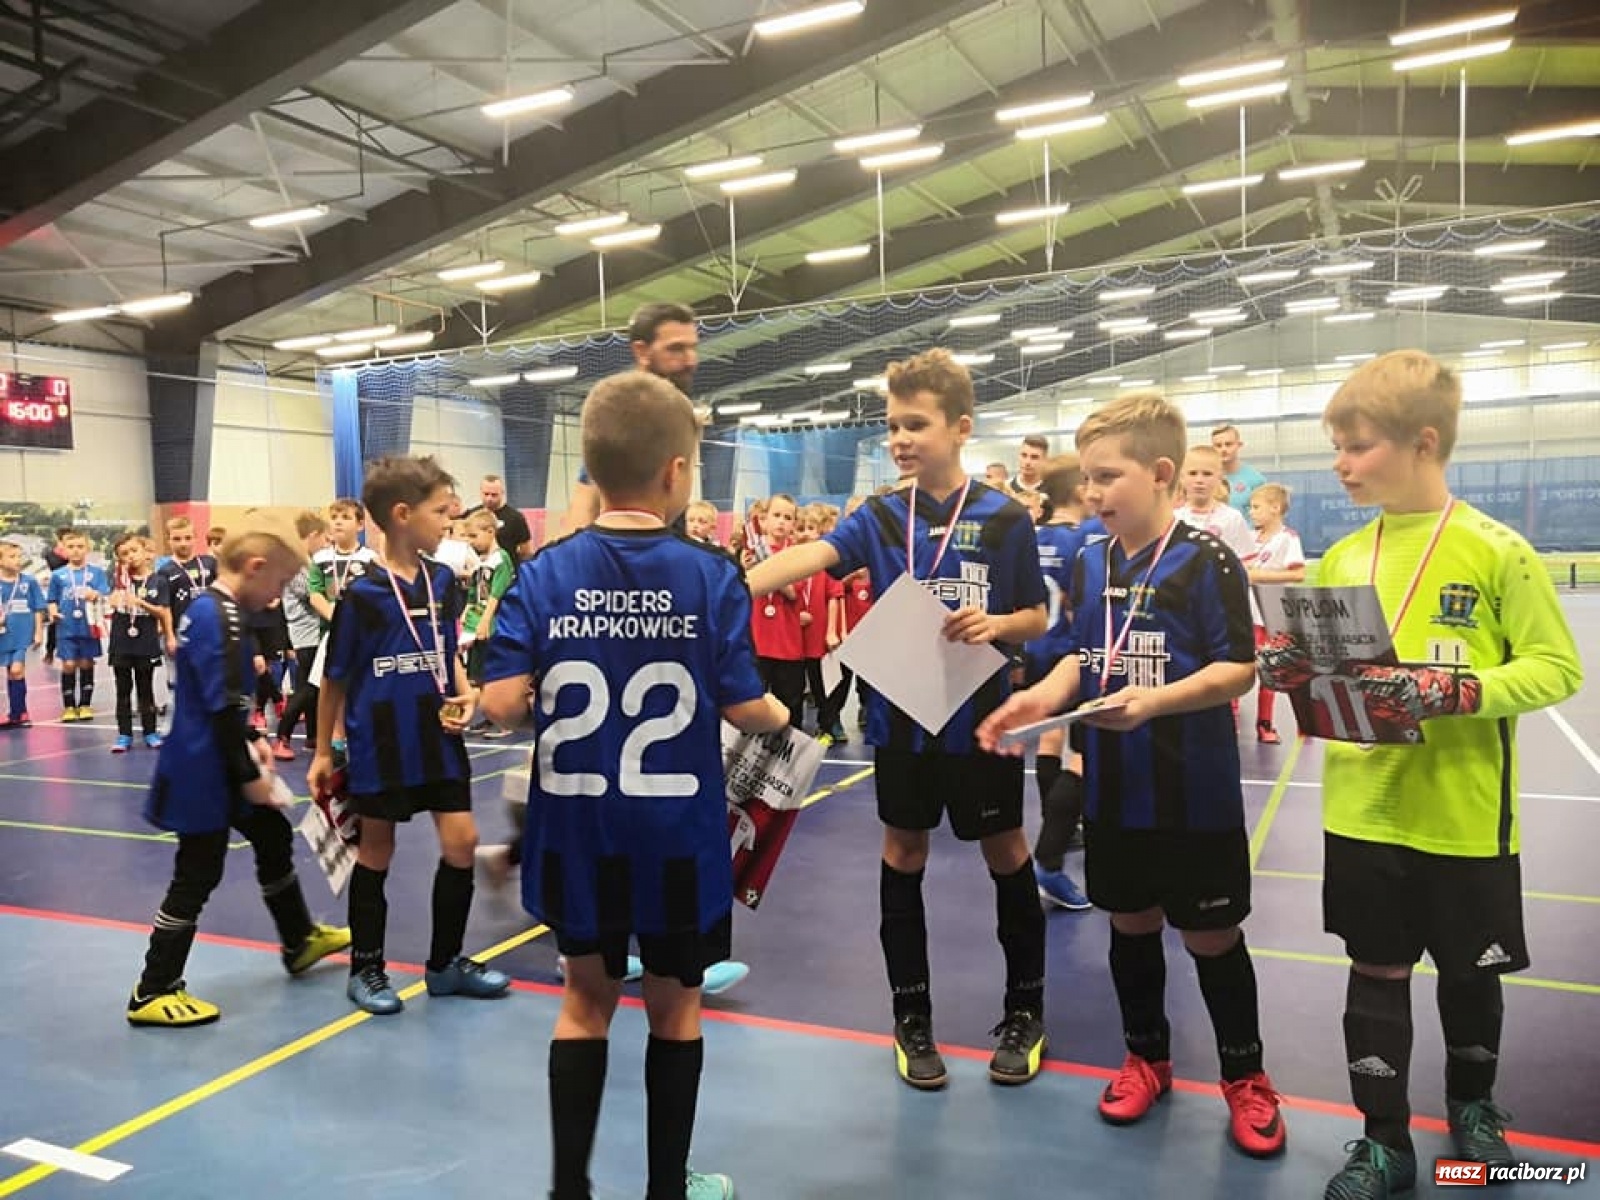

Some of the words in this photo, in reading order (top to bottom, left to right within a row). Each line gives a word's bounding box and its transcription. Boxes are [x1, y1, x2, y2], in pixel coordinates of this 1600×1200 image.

[53, 379, 66, 396] 0
[8, 402, 53, 422] 16:00
[574, 589, 673, 613] SPIDERS
[1280, 598, 1350, 618] DYPLOM
[549, 615, 698, 638] KRAPKOWICE
[538, 660, 699, 797] 22
